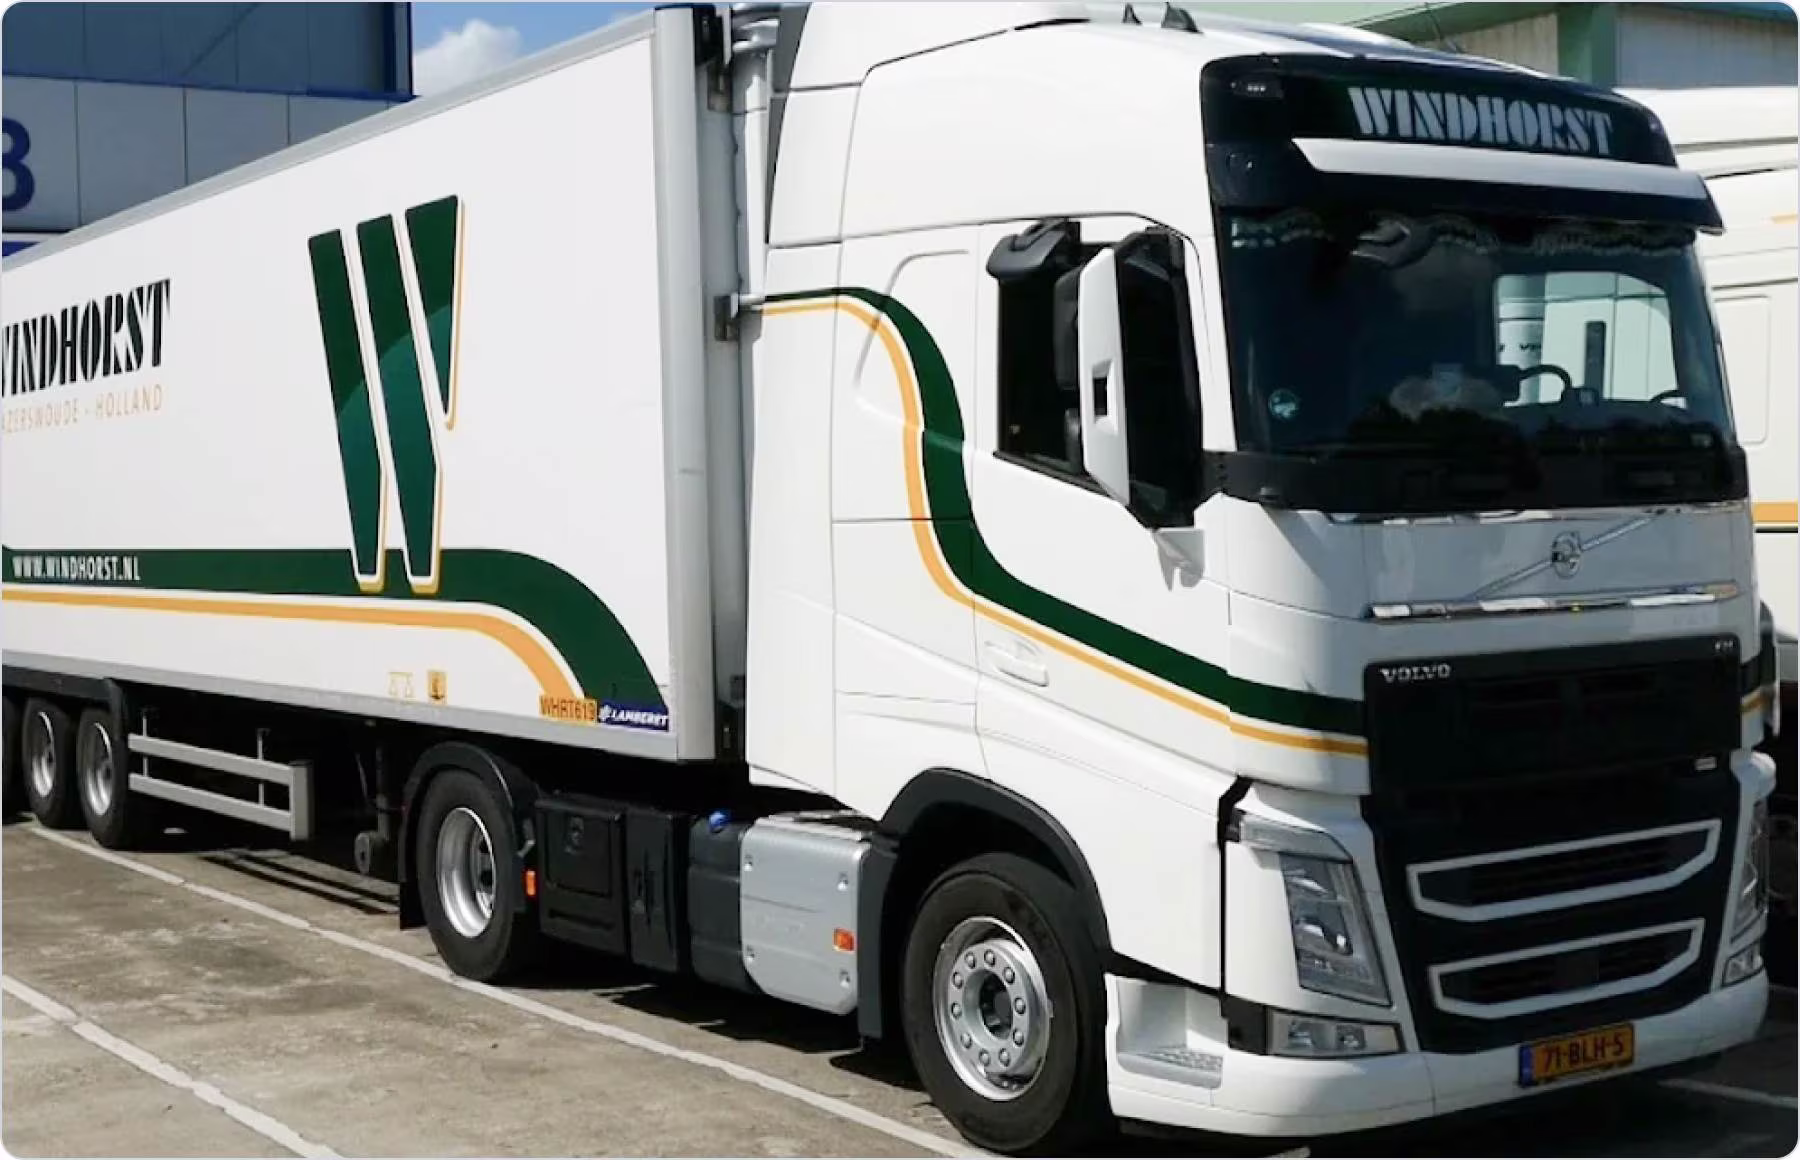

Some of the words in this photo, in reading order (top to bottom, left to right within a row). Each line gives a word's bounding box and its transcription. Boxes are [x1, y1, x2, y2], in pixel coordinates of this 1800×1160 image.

[1348, 87, 1612, 154] WINDHORST
[96, 383, 162, 419] HOLLAND
[12, 556, 141, 580] WWW.WINDHORST.NL
[1381, 663, 1451, 683] VOLVO
